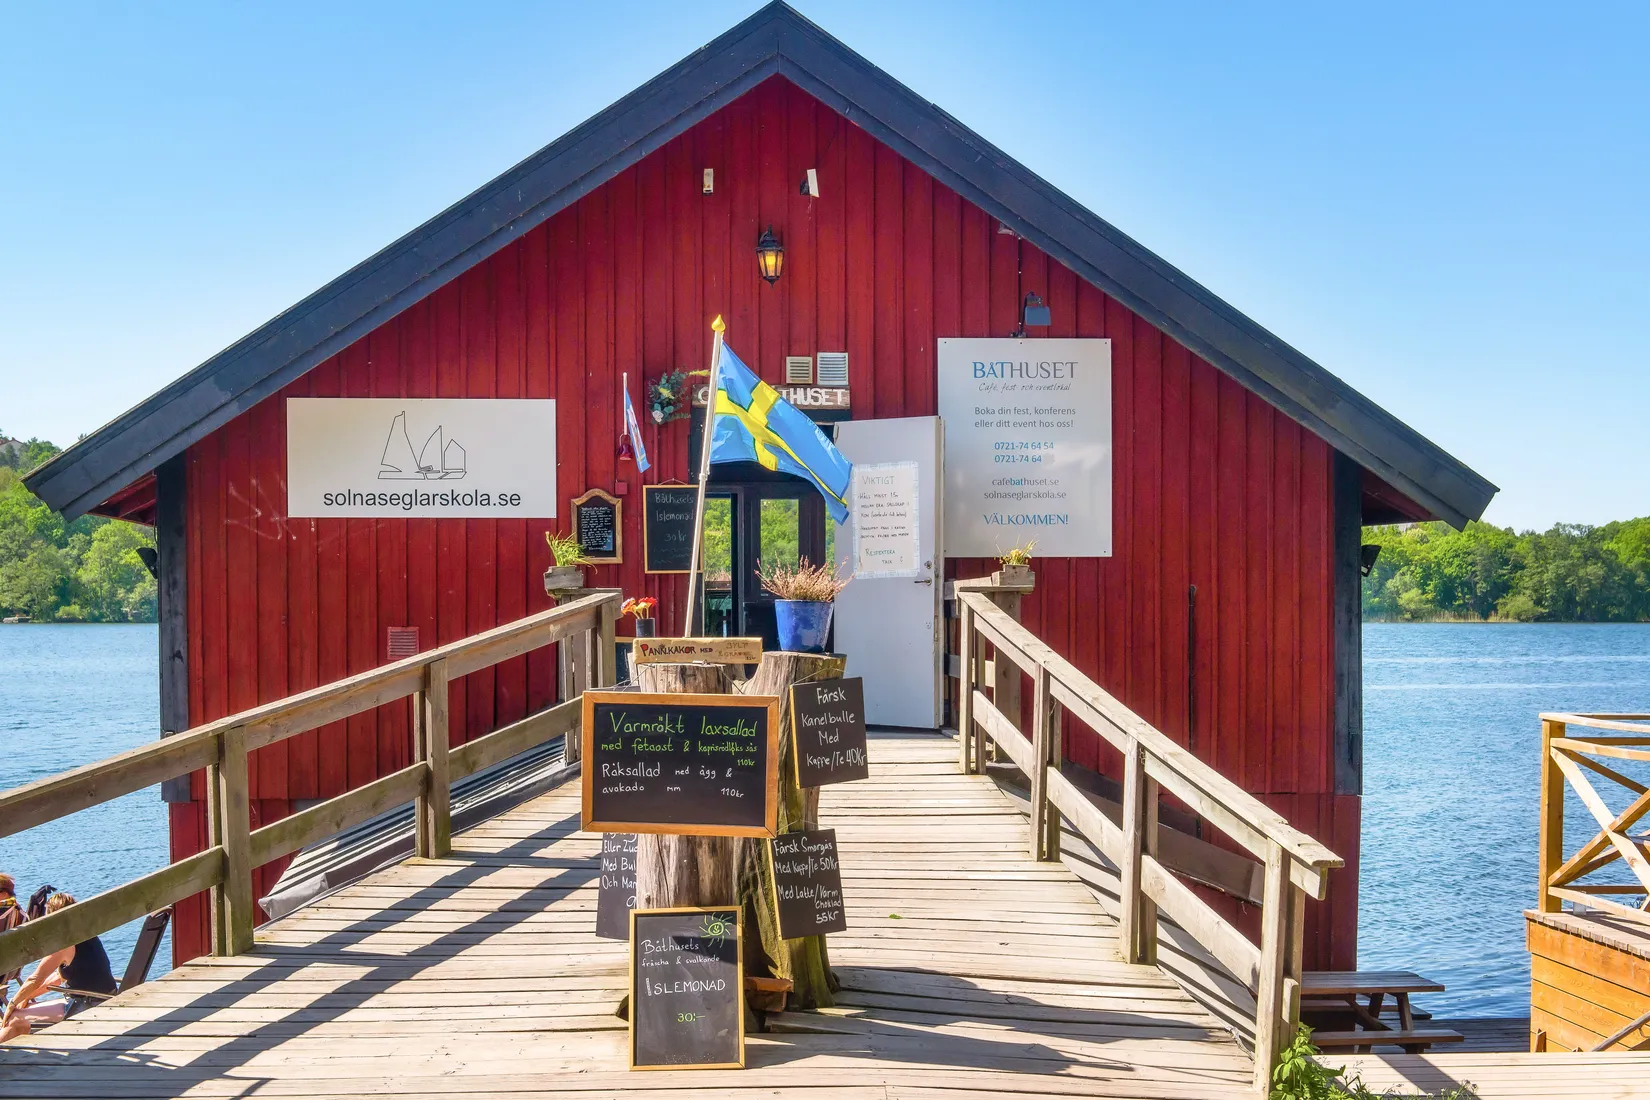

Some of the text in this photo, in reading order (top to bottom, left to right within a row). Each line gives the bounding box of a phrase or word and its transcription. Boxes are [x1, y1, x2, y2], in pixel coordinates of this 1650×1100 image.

[972, 361, 1078, 379] BÅTHUSET
[1020, 383, 1034, 391] och
[1035, 382, 1072, 391] eventlokal
[777, 388, 846, 405] THUSET
[974, 406, 1076, 417] Boka din fest, konferens
[974, 419, 1074, 428] eller ditt event hos oss!
[994, 442, 1055, 450] 0721-74 64 54
[994, 454, 1042, 463] 0721-74 64
[862, 475, 896, 485] VIKTIGT
[991, 477, 1060, 486] cafebathuset.se
[323, 489, 521, 511] solnaseglarskola.se
[984, 490, 1067, 501] solnaseglarskola.se
[656, 508, 694, 522] Islemonad
[983, 512, 1069, 525] VÄLKOMMEN!
[816, 687, 847, 705] Färsk
[610, 712, 758, 737] Varmrökt laxsallad
[818, 728, 840, 746] Med
[601, 738, 623, 751] med
[631, 738, 674, 755] fetaost
[683, 740, 691, 752] &
[699, 765, 717, 779] ägg
[725, 767, 733, 778] &
[602, 782, 645, 795] avokado
[720, 787, 744, 798] 110kr
[604, 840, 622, 854] Eller
[602, 857, 617, 872] Med
[775, 861, 792, 874] Med
[602, 875, 618, 890] Och
[777, 884, 794, 901] Med
[640, 936, 699, 955] Båthusets
[675, 955, 682, 965] &
[645, 977, 726, 997] ISLEMONAD
